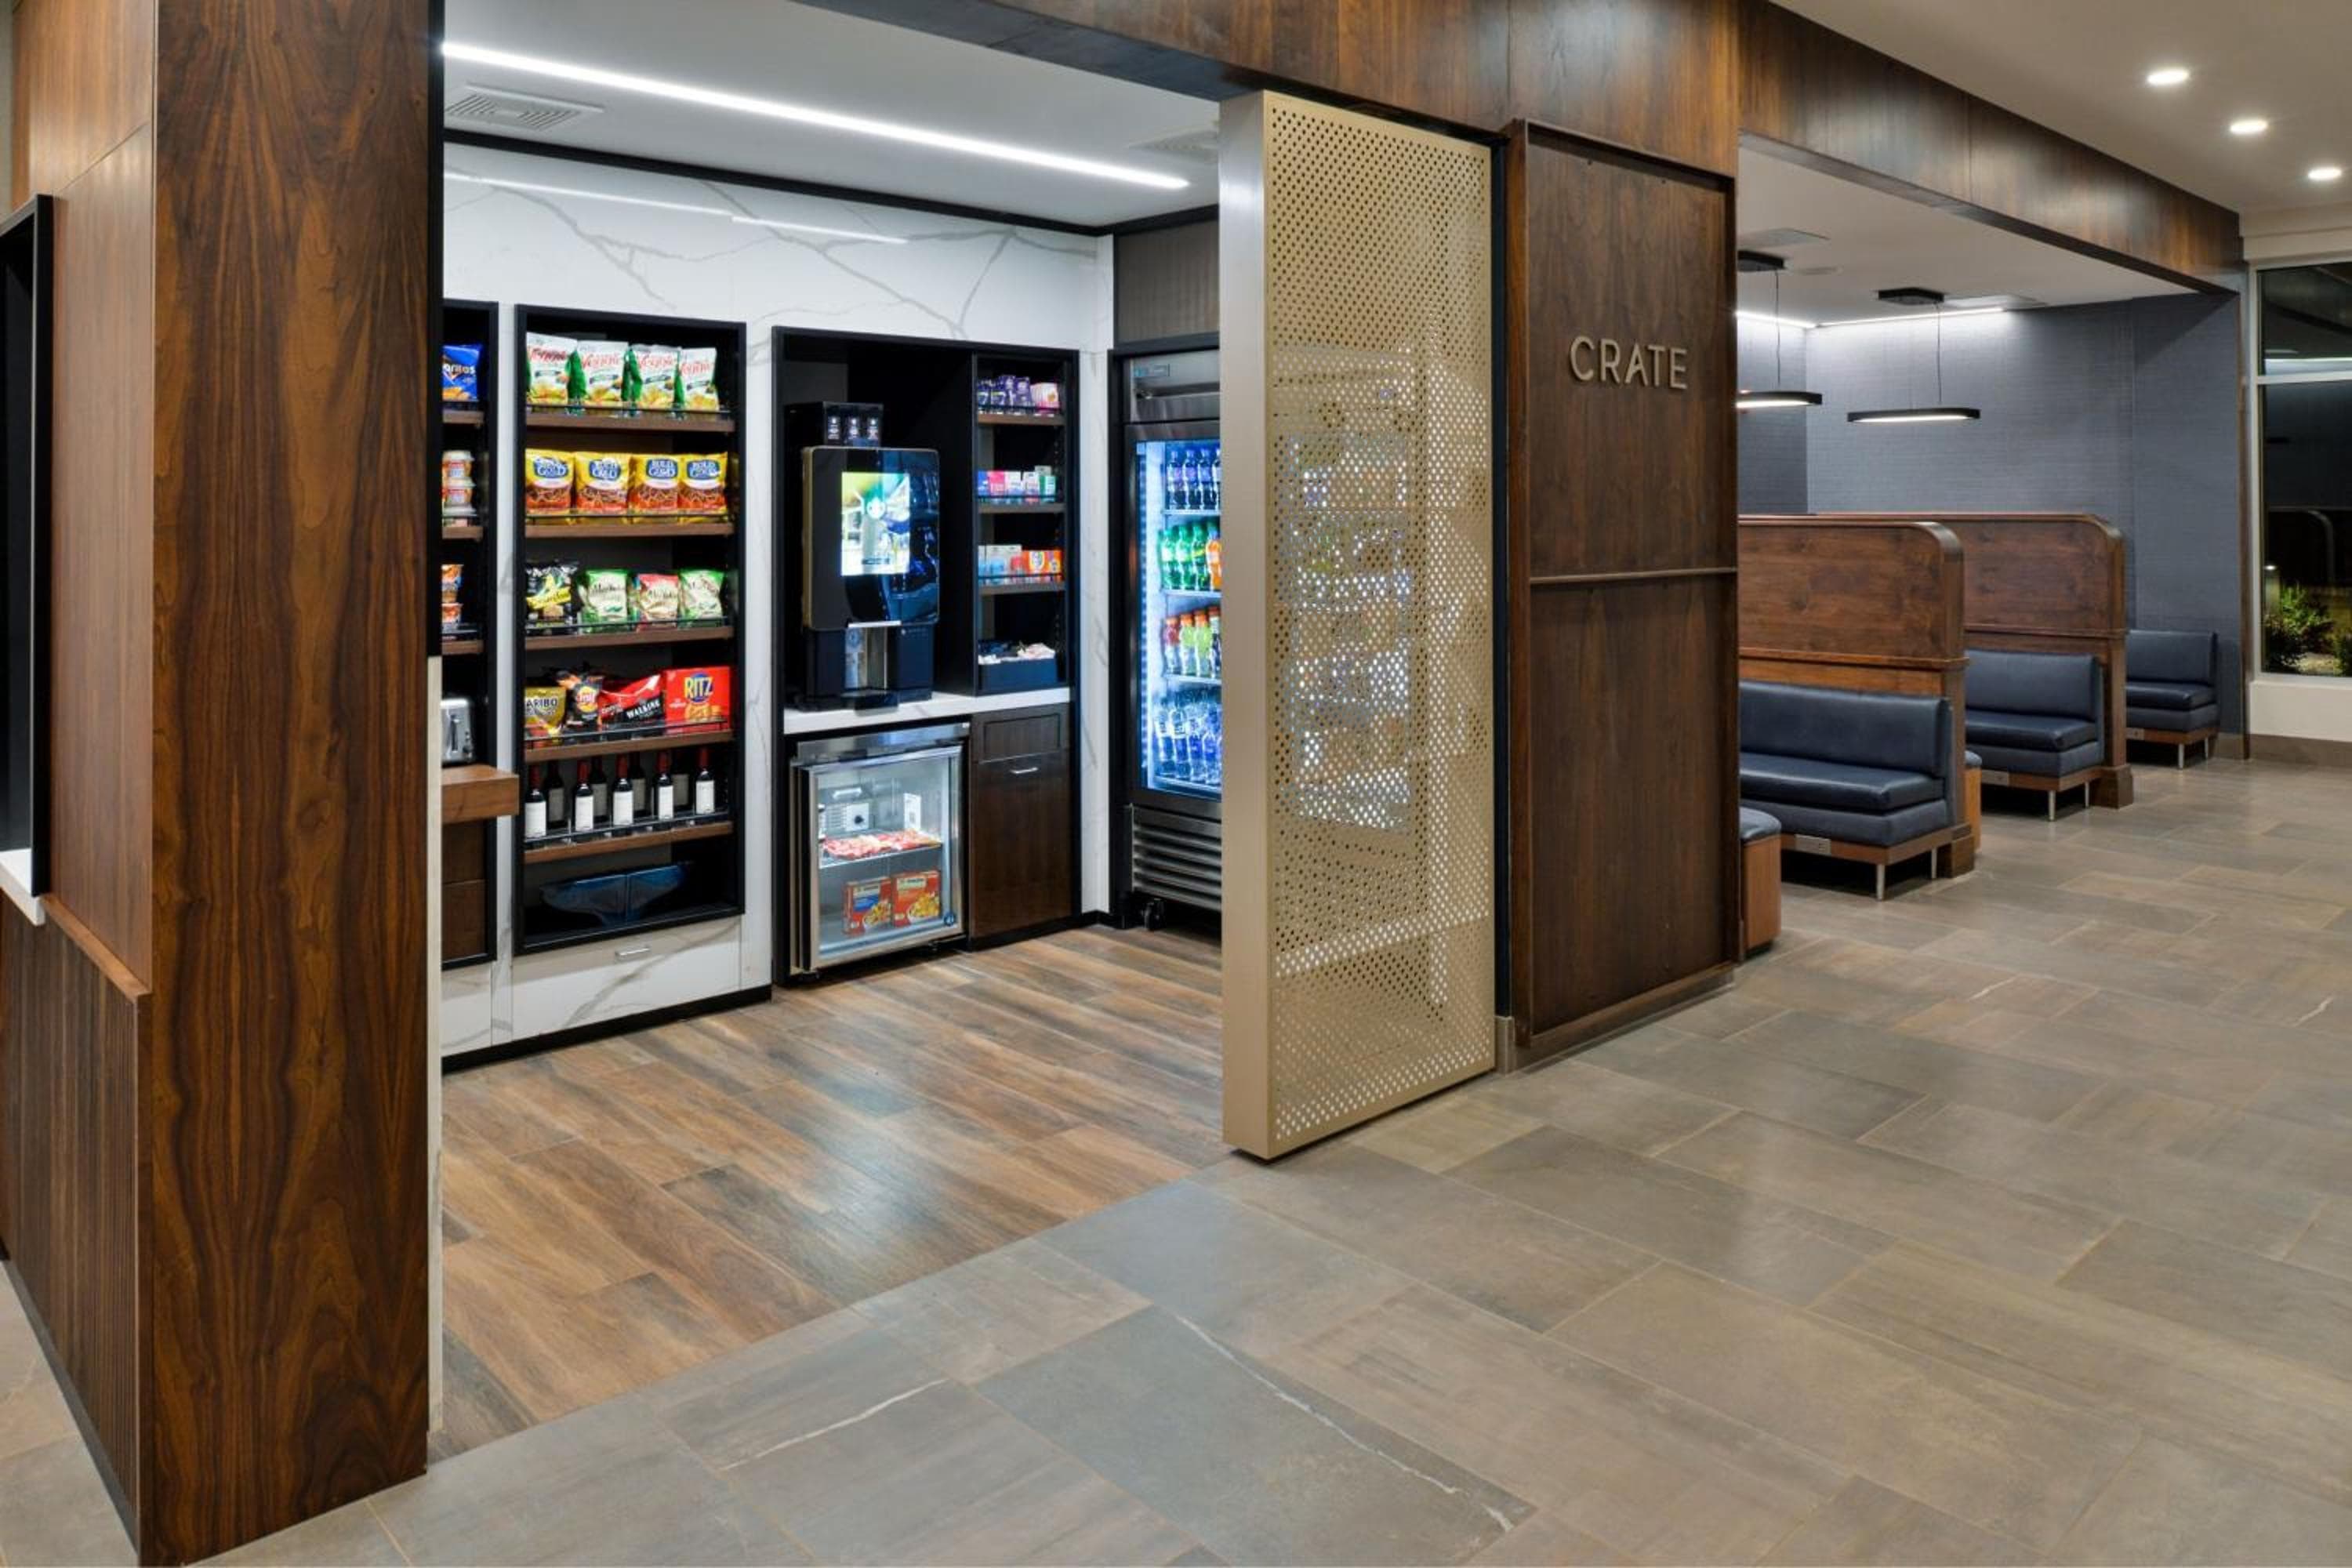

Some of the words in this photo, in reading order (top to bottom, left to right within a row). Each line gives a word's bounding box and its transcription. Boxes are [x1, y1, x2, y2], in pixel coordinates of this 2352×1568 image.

[442, 363, 477, 375] oritos
[1570, 336, 1688, 390] CRATE
[684, 677, 714, 699] RITZ
[526, 697, 558, 708] ARIBO
